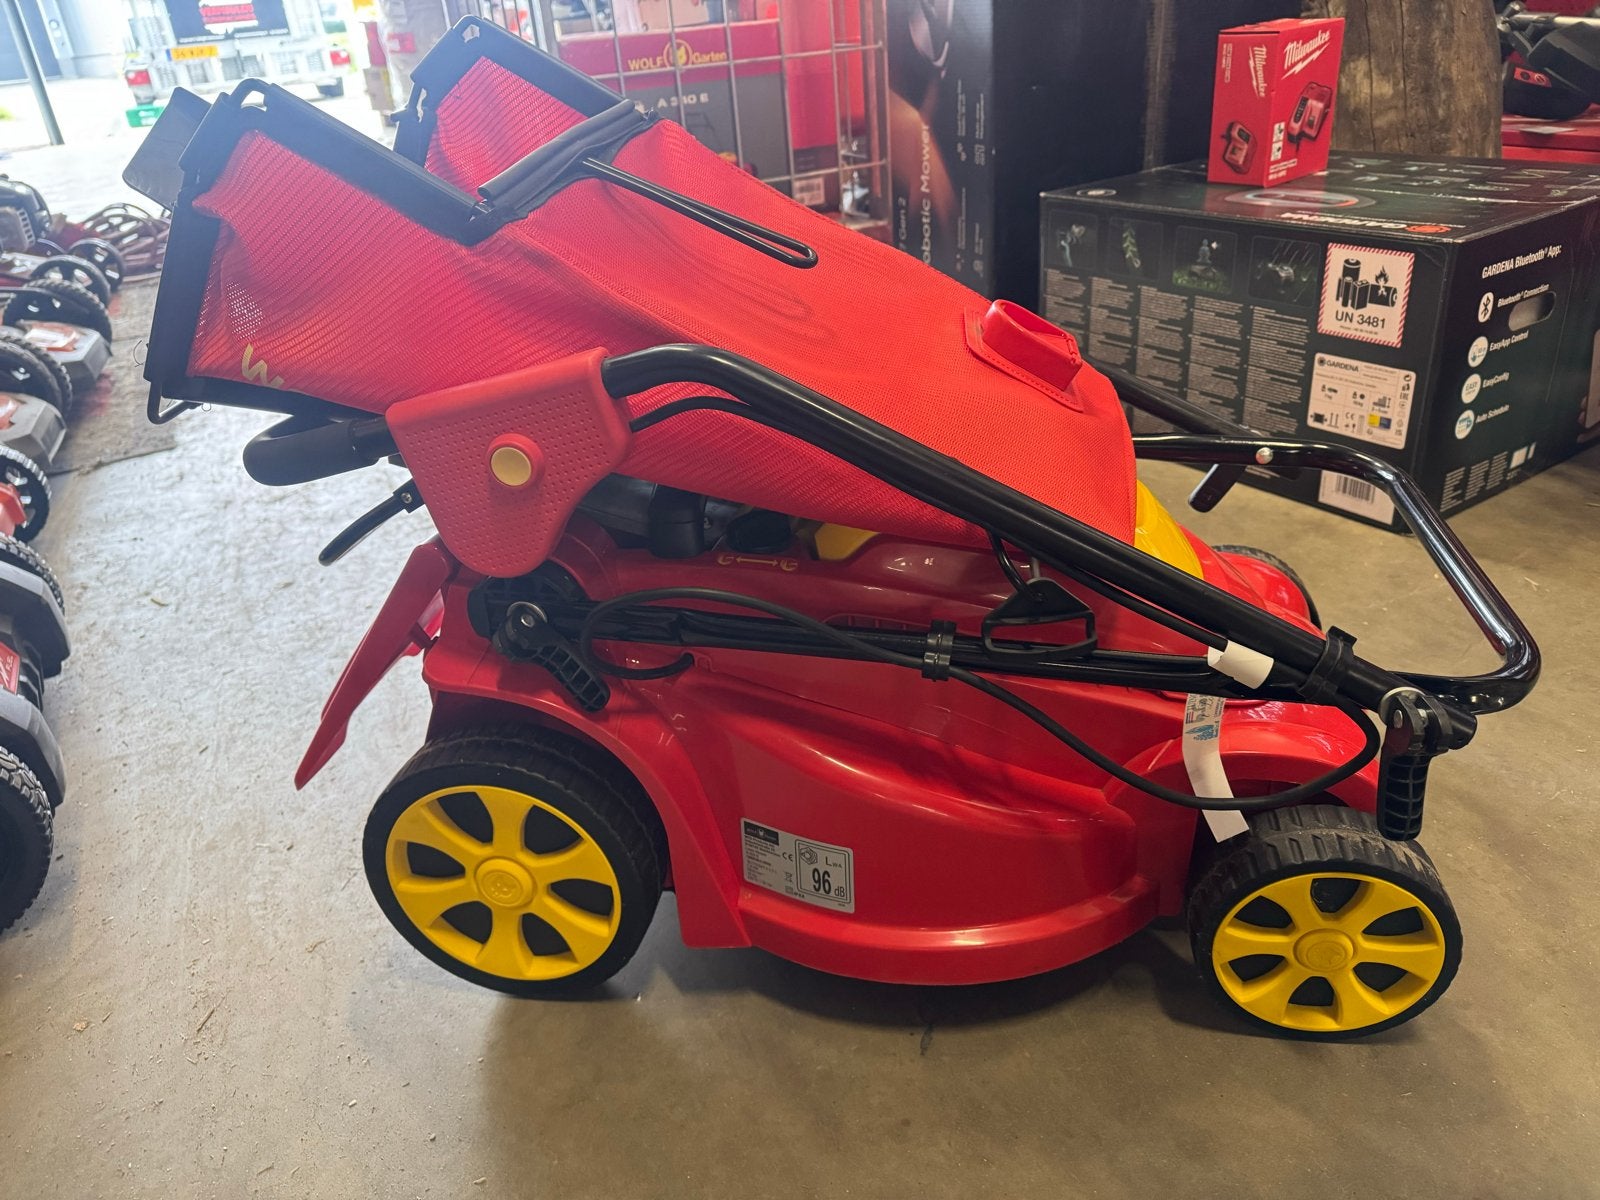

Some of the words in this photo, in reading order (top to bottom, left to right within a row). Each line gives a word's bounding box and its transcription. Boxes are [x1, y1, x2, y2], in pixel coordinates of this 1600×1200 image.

[1283, 29, 1331, 70] Milwaukee
[628, 57, 664, 71] WOLF
[1253, 44, 1267, 98] Milwaukee
[920, 124, 931, 193] Mower
[920, 199, 932, 265] obotic
[1482, 258, 1514, 279] GARDENA
[1547, 244, 1562, 259] App:
[1523, 283, 1550, 299] Connection
[1335, 310, 1354, 324] UN
[1356, 314, 1386, 329] 3481
[1490, 337, 1511, 352] EasyApp
[1511, 330, 1530, 344] Control
[1326, 360, 1359, 373] GARDENA
[1482, 371, 1510, 388] EasyConfig
[1475, 412, 1488, 424] Auto
[812, 867, 832, 895] 96
[834, 886, 846, 898] dB
